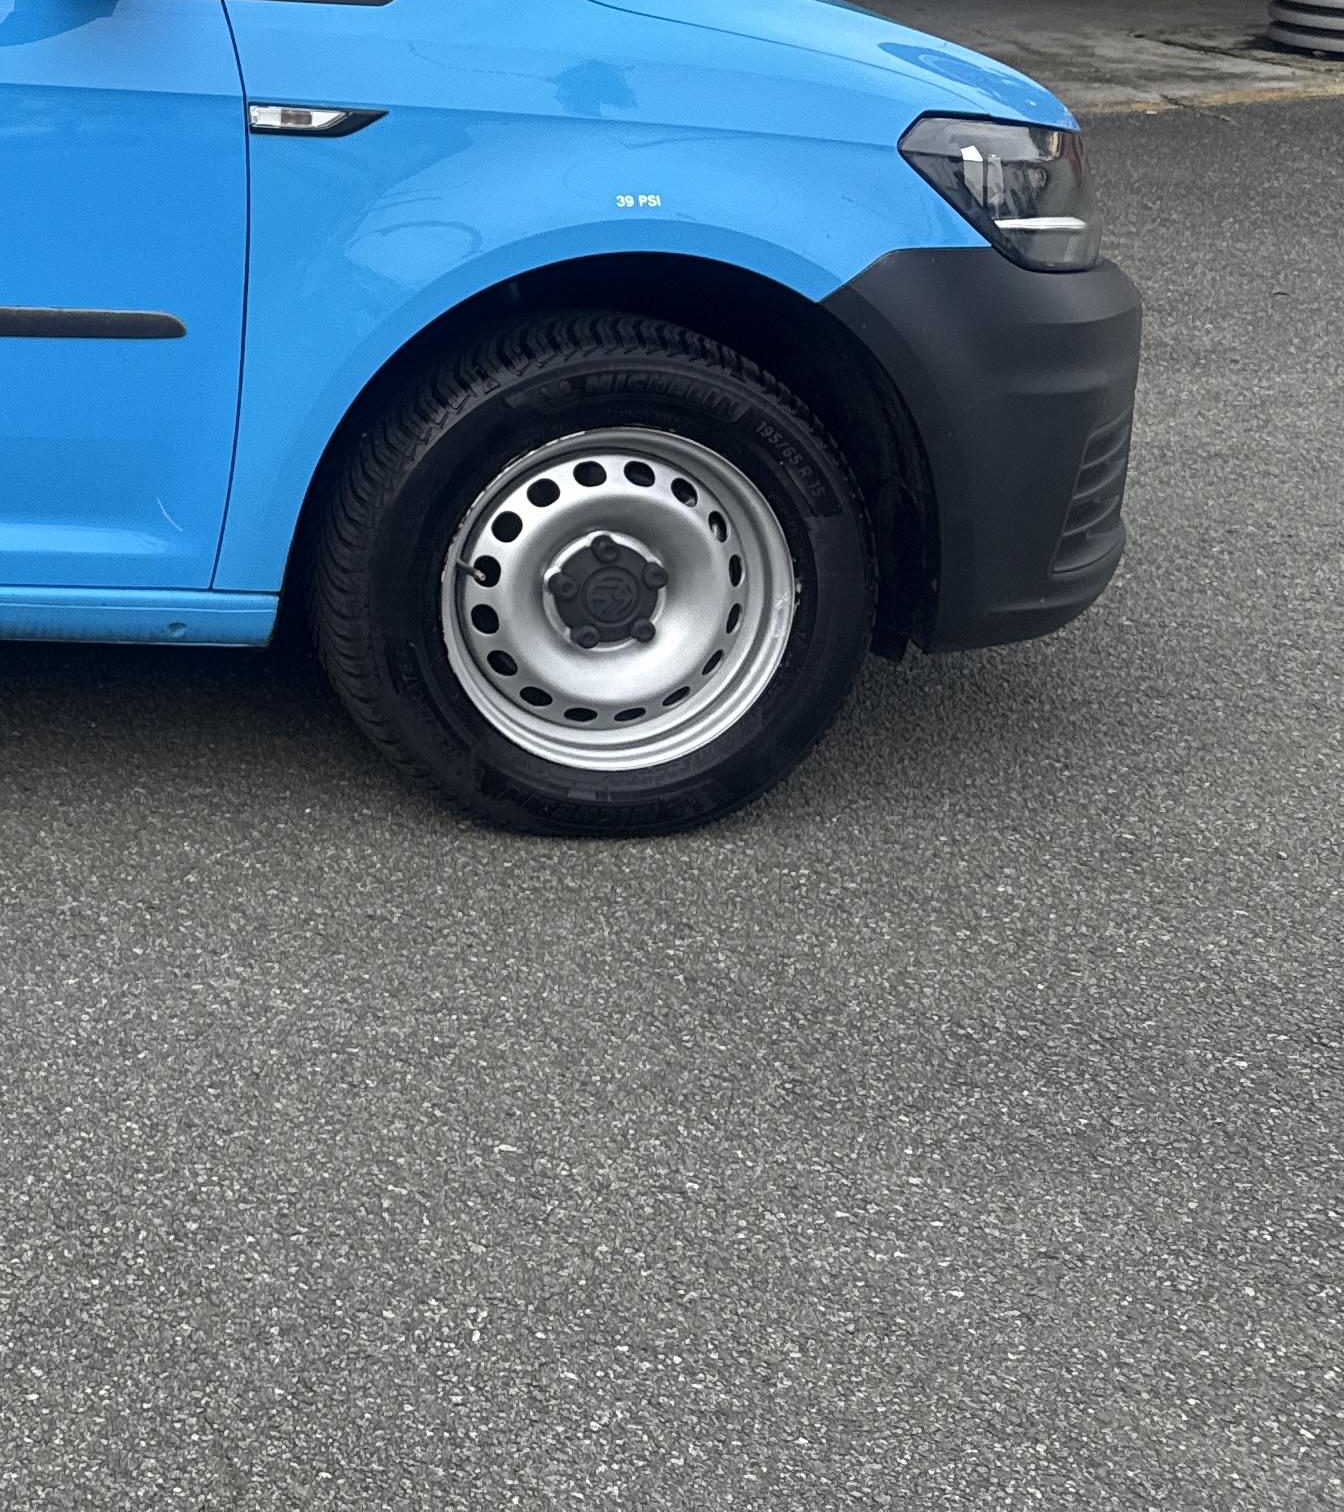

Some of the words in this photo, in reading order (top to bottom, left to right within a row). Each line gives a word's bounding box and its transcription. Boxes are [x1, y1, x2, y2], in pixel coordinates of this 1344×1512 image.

[615, 194, 635, 208] 39
[638, 194, 662, 207] PSI
[755, 420, 804, 466] 195/65
